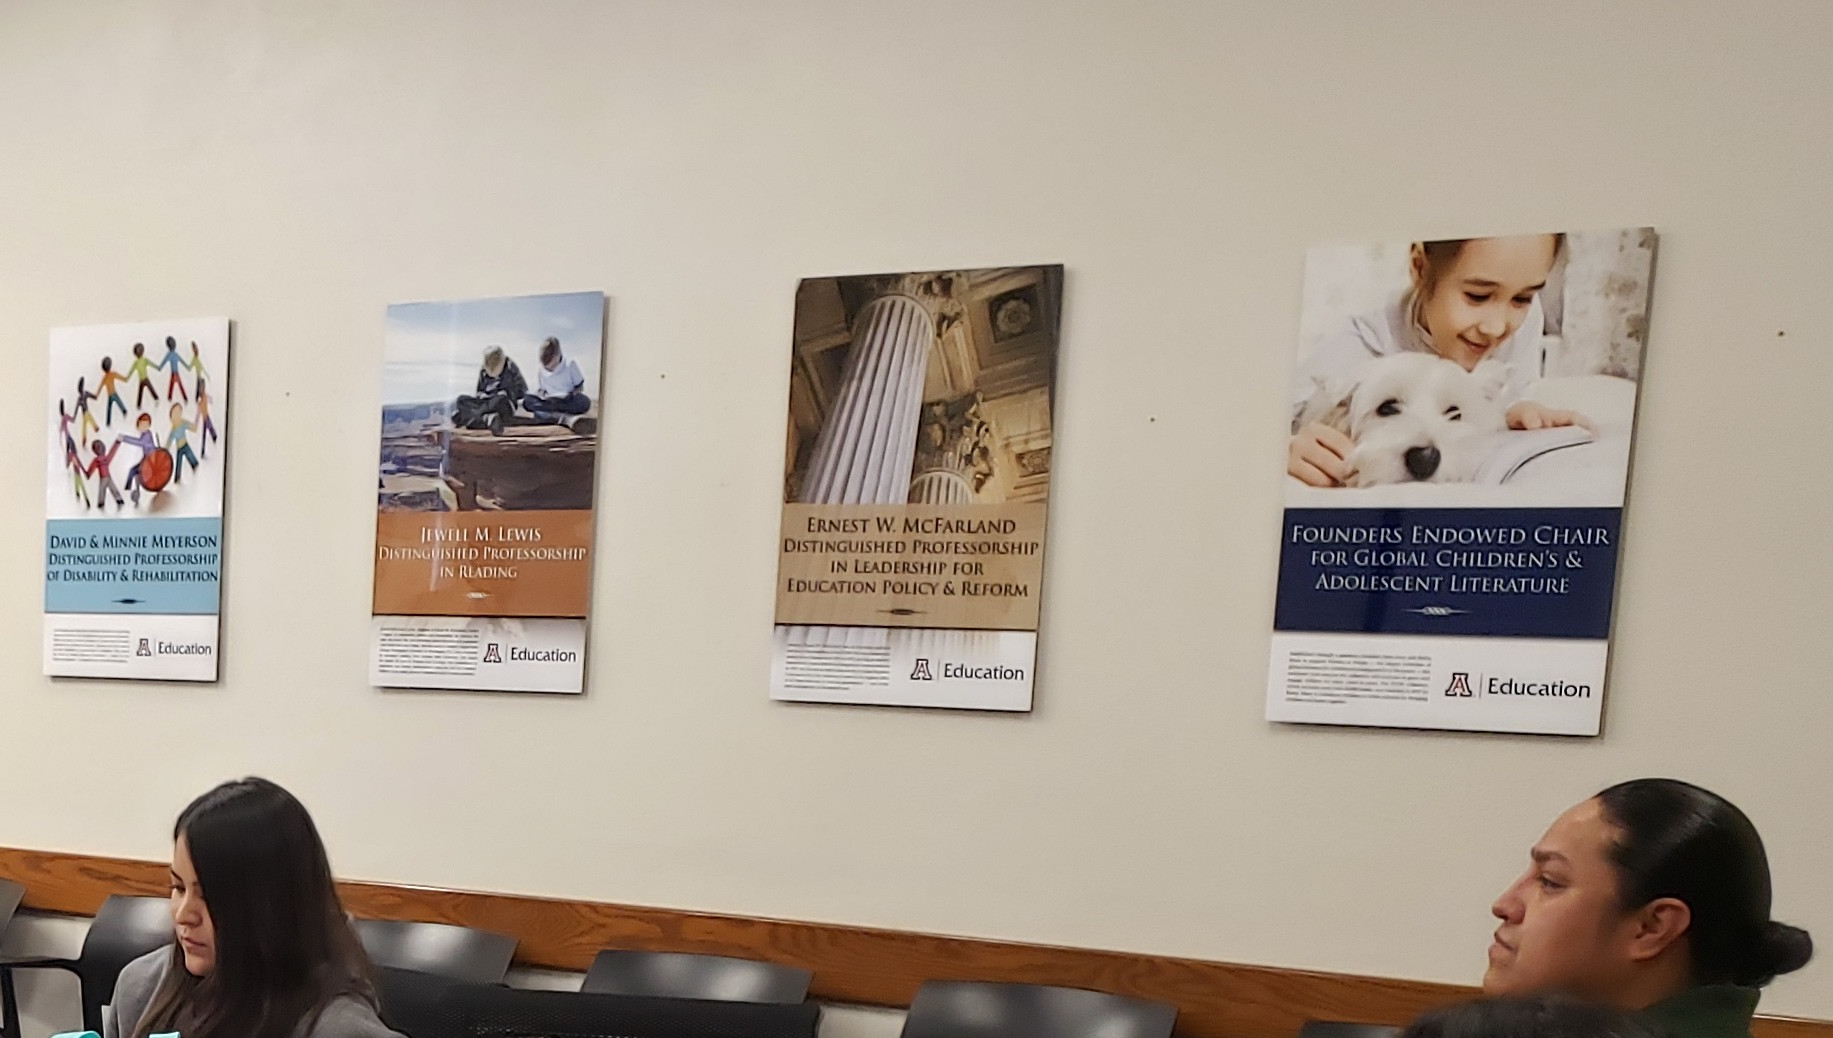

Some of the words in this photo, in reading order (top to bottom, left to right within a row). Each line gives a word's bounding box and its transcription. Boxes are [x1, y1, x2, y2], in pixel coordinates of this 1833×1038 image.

[807, 517, 870, 533] ERNEST
[877, 518, 895, 533] W.
[50, 535, 86, 548] DAVID
[90, 535, 98, 549] &
[103, 536, 147, 548] MINNIE
[152, 535, 217, 548] MEYERSON
[421, 527, 467, 543] JEWELL
[476, 528, 492, 541] M.
[499, 527, 541, 542] LEWIS
[1292, 525, 1402, 544] FOUNDERS
[1411, 526, 1526, 544] ENDOWED
[1534, 526, 1610, 545] CHAIR
[379, 546, 478, 560] DISTINGUISHED
[484, 547, 586, 560] PROFESSORSHIP
[784, 539, 906, 554] DISTINGUISHED
[913, 540, 1038, 555] PROFESSORSHIP
[49, 554, 130, 565] DISTINGUISHED
[135, 553, 217, 565] PROFESSORSHIP
[1311, 550, 1348, 565] FOR
[1353, 549, 1429, 567] GLOBAL
[1436, 550, 1558, 568] CHILDREN'S
[1566, 551, 1583, 568] &
[63, 570, 117, 581] DISABILITY
[120, 569, 128, 581] &
[133, 570, 217, 581] REHABILITATION
[441, 567, 454, 578] IN
[459, 565, 517, 578] READING
[831, 561, 847, 574] IN
[854, 560, 947, 575] LEADERSHIP
[953, 562, 984, 575] FOR
[787, 578, 876, 593] EDUCATION
[883, 580, 939, 596] POLICY
[943, 581, 955, 596] &
[961, 581, 1028, 597] REFORM
[1315, 573, 1443, 592] ADOLESCENT
[1450, 575, 1570, 594] LITERATURE
[158, 642, 211, 655] Education
[511, 647, 576, 662] Education
[944, 663, 1024, 681] Education
[1488, 678, 1590, 698] Education
